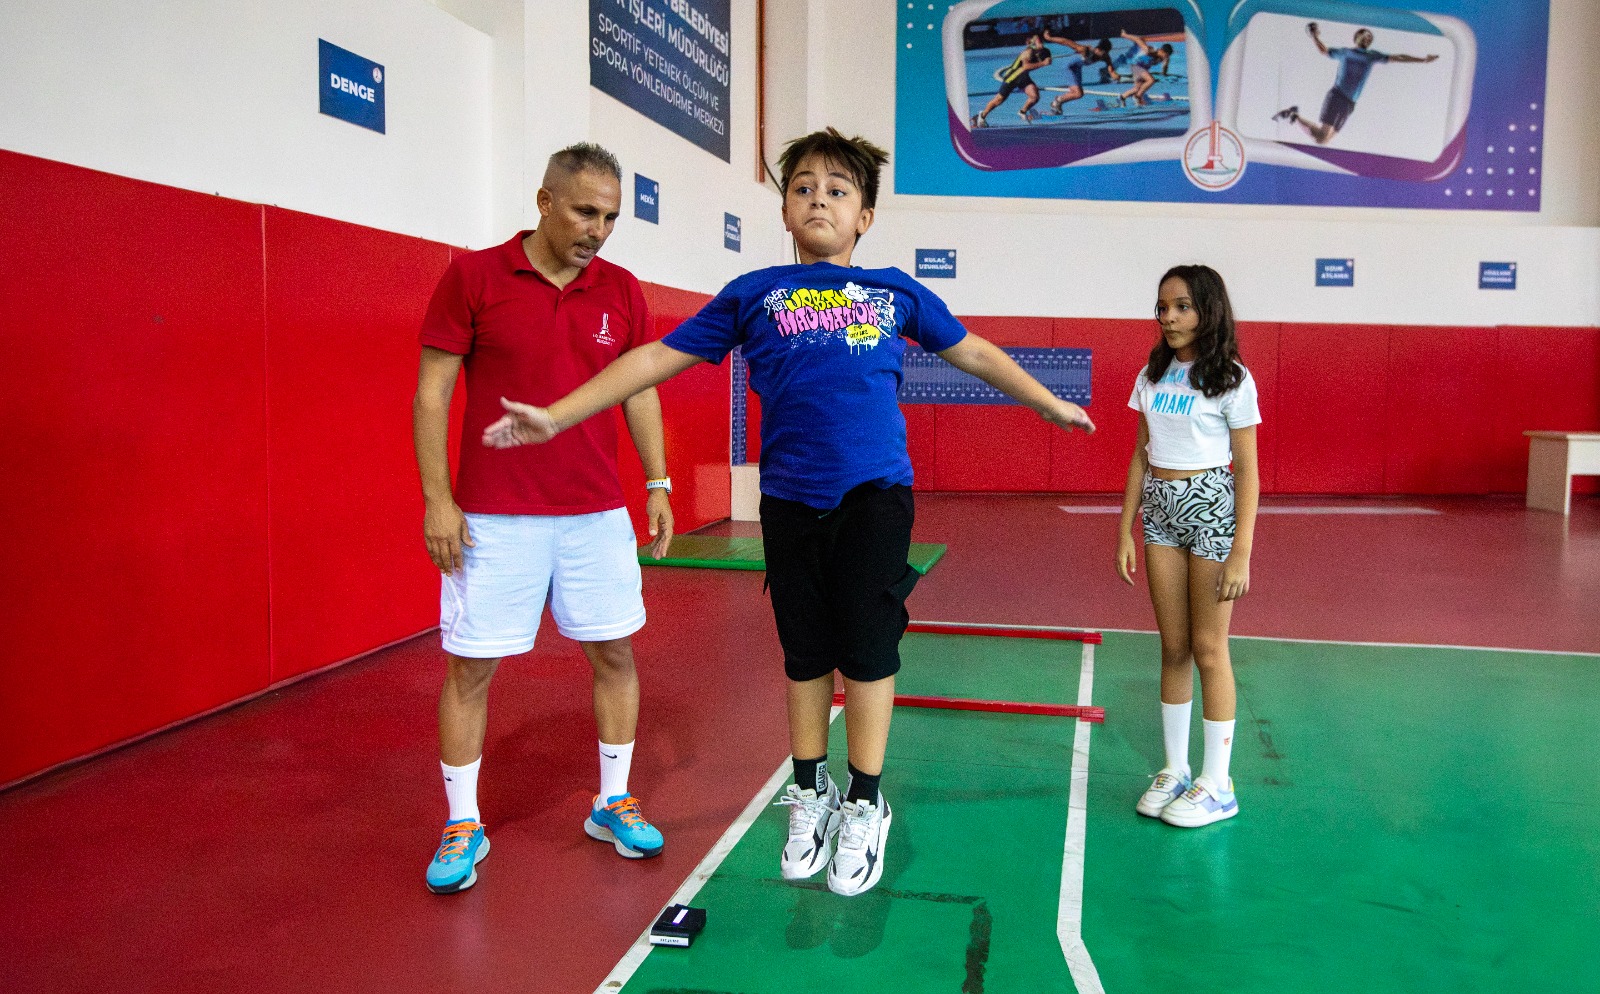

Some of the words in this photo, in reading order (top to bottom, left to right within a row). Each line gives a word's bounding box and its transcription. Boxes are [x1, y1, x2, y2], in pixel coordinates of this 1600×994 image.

[592, 37, 629, 76] SPORA
[630, 61, 693, 116] YÖNLENDİRME
[693, 104, 724, 136] MERKEZİ
[598, 13, 642, 55] SPORTİF
[642, 43, 682, 85] YETENEK
[682, 70, 709, 104] ÖLÇÜM
[709, 92, 719, 112] VE
[668, 23, 729, 87] MÜDÜRLÜĞÜ
[330, 72, 375, 103] DENGE
[1150, 392, 1195, 416] MIAMI
